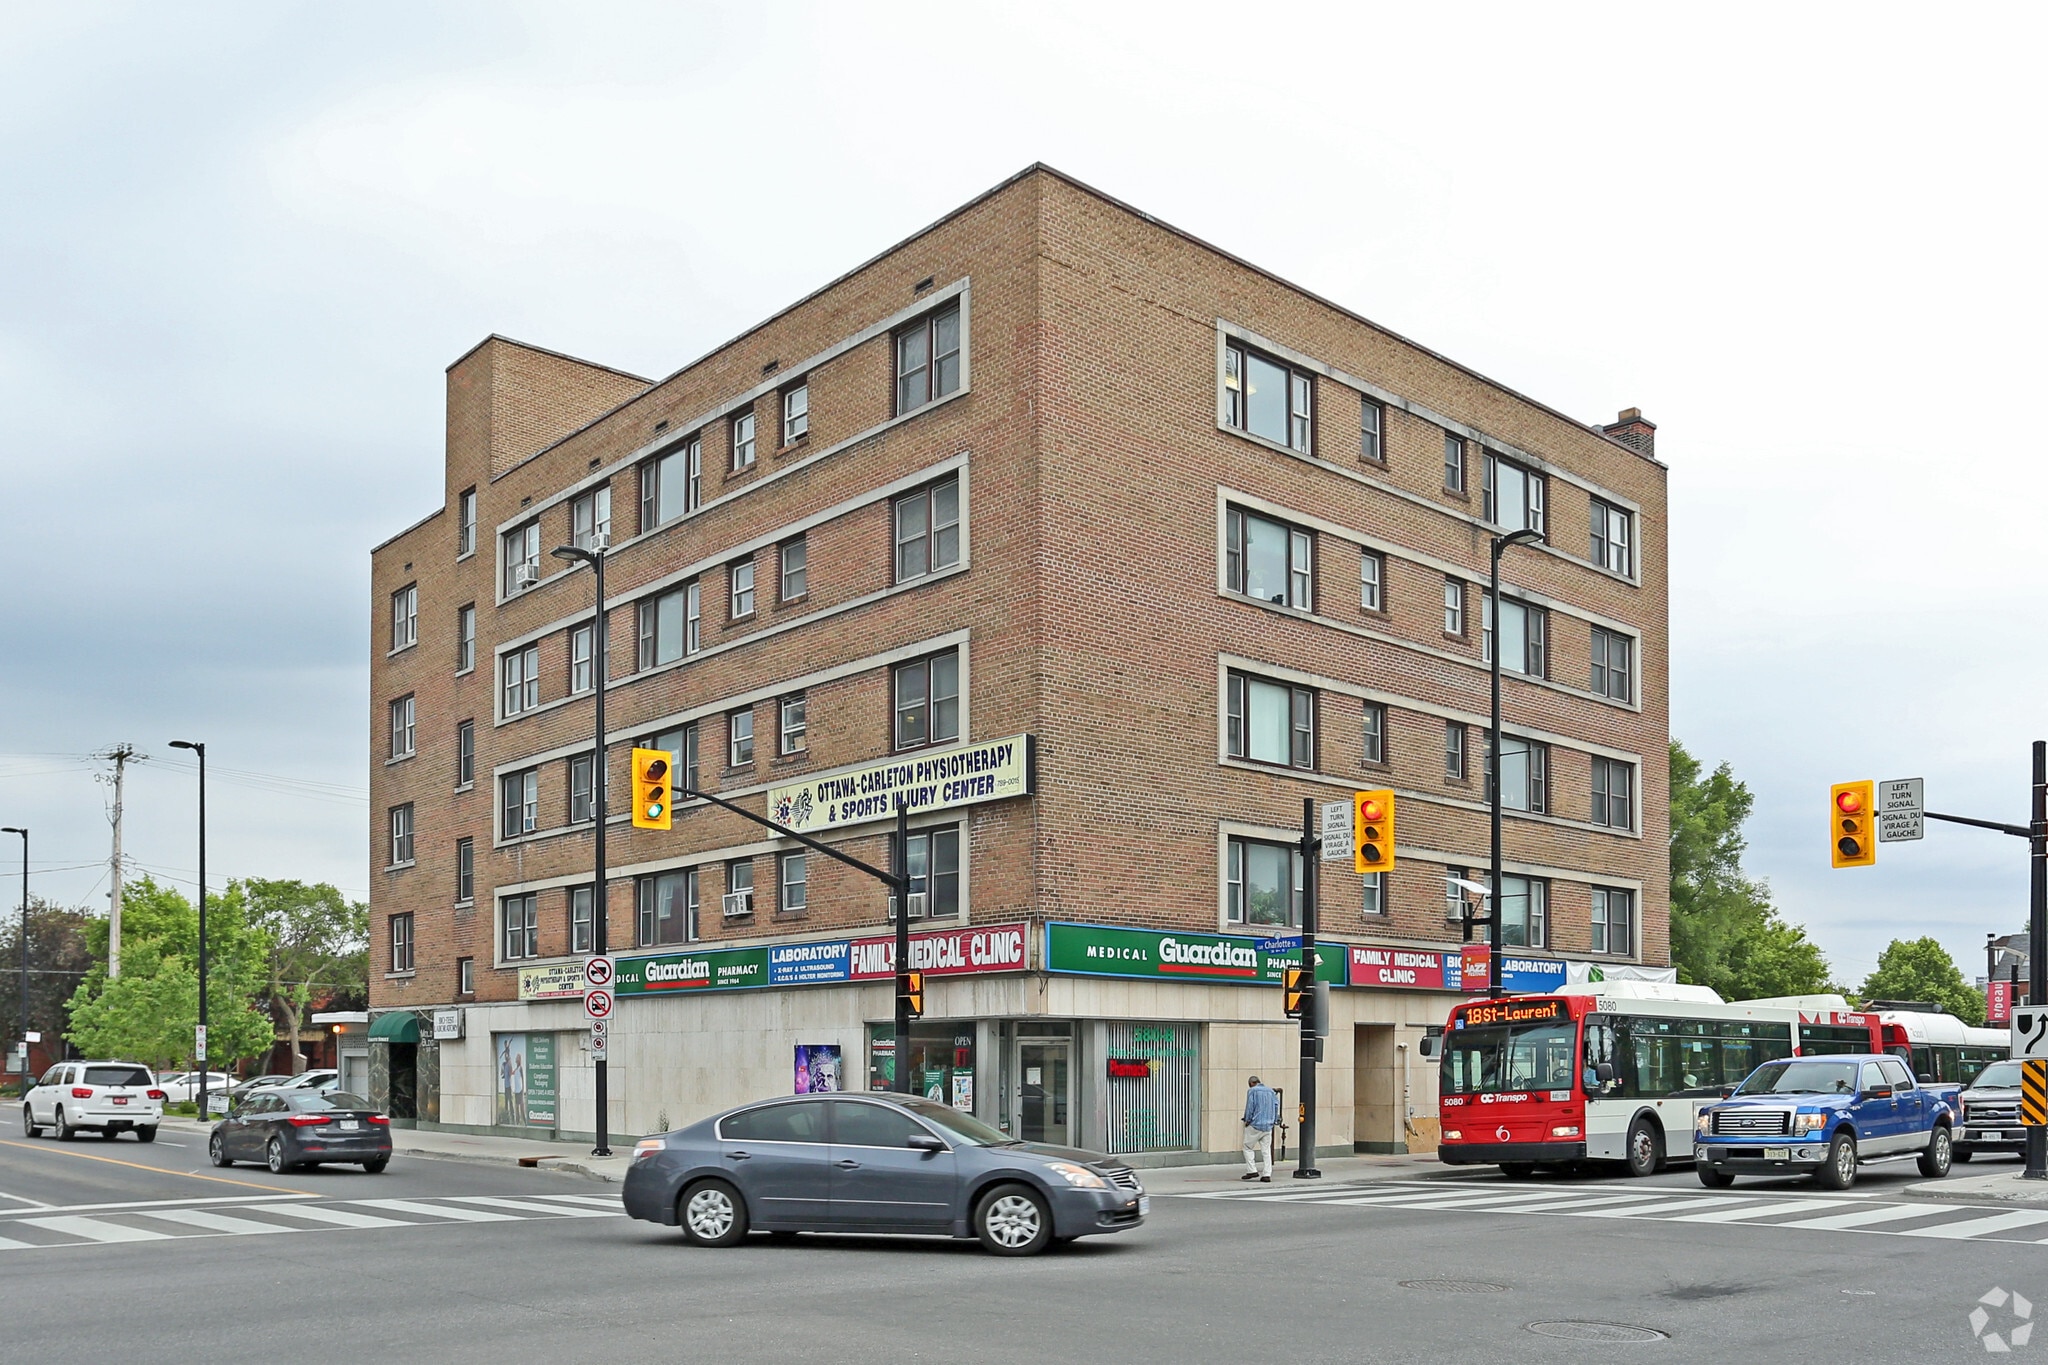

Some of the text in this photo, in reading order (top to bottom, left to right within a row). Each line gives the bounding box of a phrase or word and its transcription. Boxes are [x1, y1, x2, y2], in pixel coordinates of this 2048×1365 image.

[817, 745, 1012, 802] OTTAWA-CARLETON PHYSIOTHERAPY
[1892, 783, 1910, 791] LEFT
[829, 774, 994, 823] & SPORTS INJURY CENTER
[1891, 792, 1912, 800] TURN
[1887, 801, 1915, 809] SIGNAL
[1330, 813, 1345, 821] TURN
[1882, 811, 1921, 822] SIGNAL DU
[1884, 821, 1911, 830] VIRAGE
[1324, 831, 1351, 842] SIGNAL DU
[1887, 829, 1917, 838] GAUCHE
[1325, 841, 1343, 849] VIRAGE
[1264, 939, 1291, 950] Charlotte
[771, 943, 849, 964] LABORATORY
[850, 942, 897, 975] FAMILY
[970, 931, 1022, 966] CLINIC
[1086, 945, 1148, 961] MEDICAL
[1158, 937, 1258, 967] Guardian
[1353, 949, 1439, 969] FAMILY MEDICAL
[645, 958, 710, 982] Guardian
[717, 964, 759, 977] PHARMACY
[800, 963, 835, 972] ULTRASOUND
[1464, 962, 1487, 974] JAZZ
[1501, 958, 1564, 975] ABORATORY
[1266, 971, 1282, 979] SINCE
[1378, 968, 1417, 985] CLINIC
[559, 982, 574, 990] CENTER
[1598, 1000, 1617, 1011] 5080
[1846, 1013, 1866, 1027] Transpo
[954, 1036, 972, 1046] OPEN
[1444, 1097, 1464, 1107] 5080
[1495, 1093, 1528, 1105] Transpo
